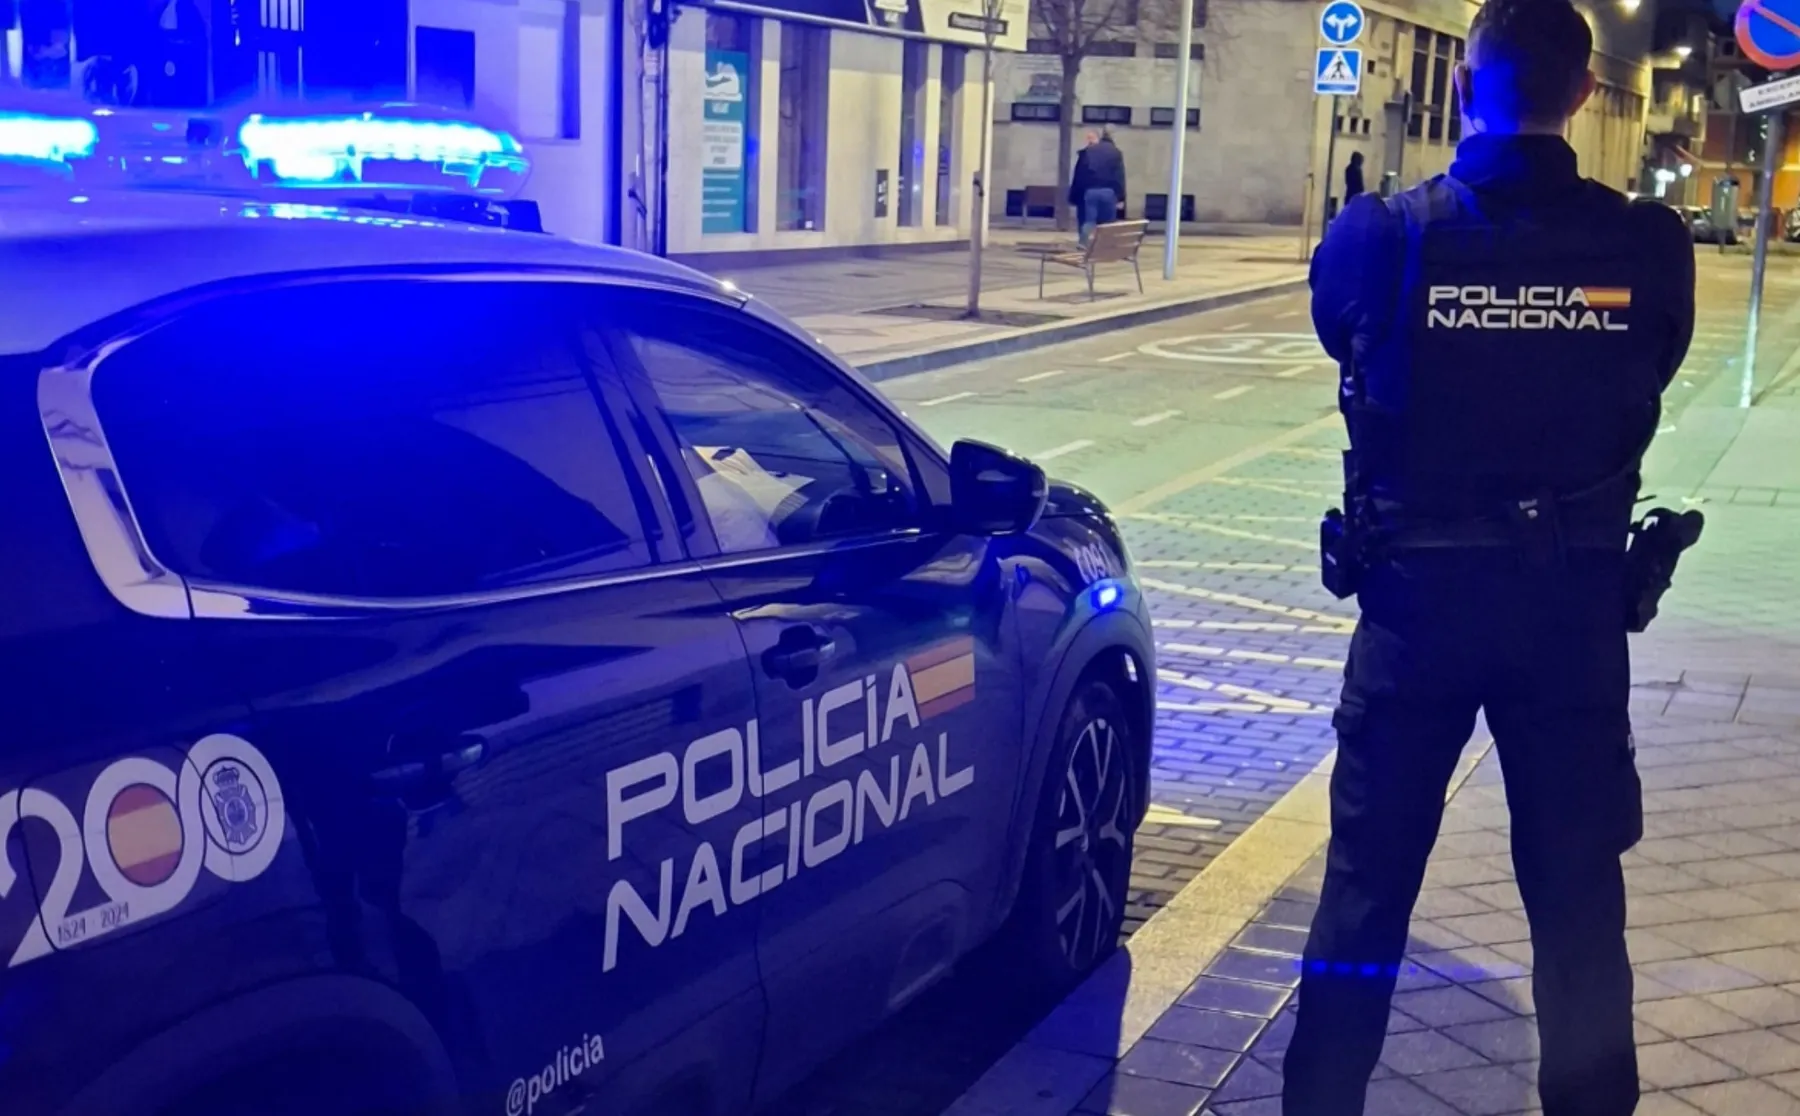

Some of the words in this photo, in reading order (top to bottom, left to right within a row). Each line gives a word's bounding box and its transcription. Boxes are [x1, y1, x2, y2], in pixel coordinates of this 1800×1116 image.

[1427, 308, 1629, 331] NACIONAL
[0, 733, 285, 968] 200
[602, 732, 974, 973] NACIONAL
[57, 917, 86, 944] 1824
[101, 901, 129, 929] 2024
[506, 1032, 604, 1116] @policia
